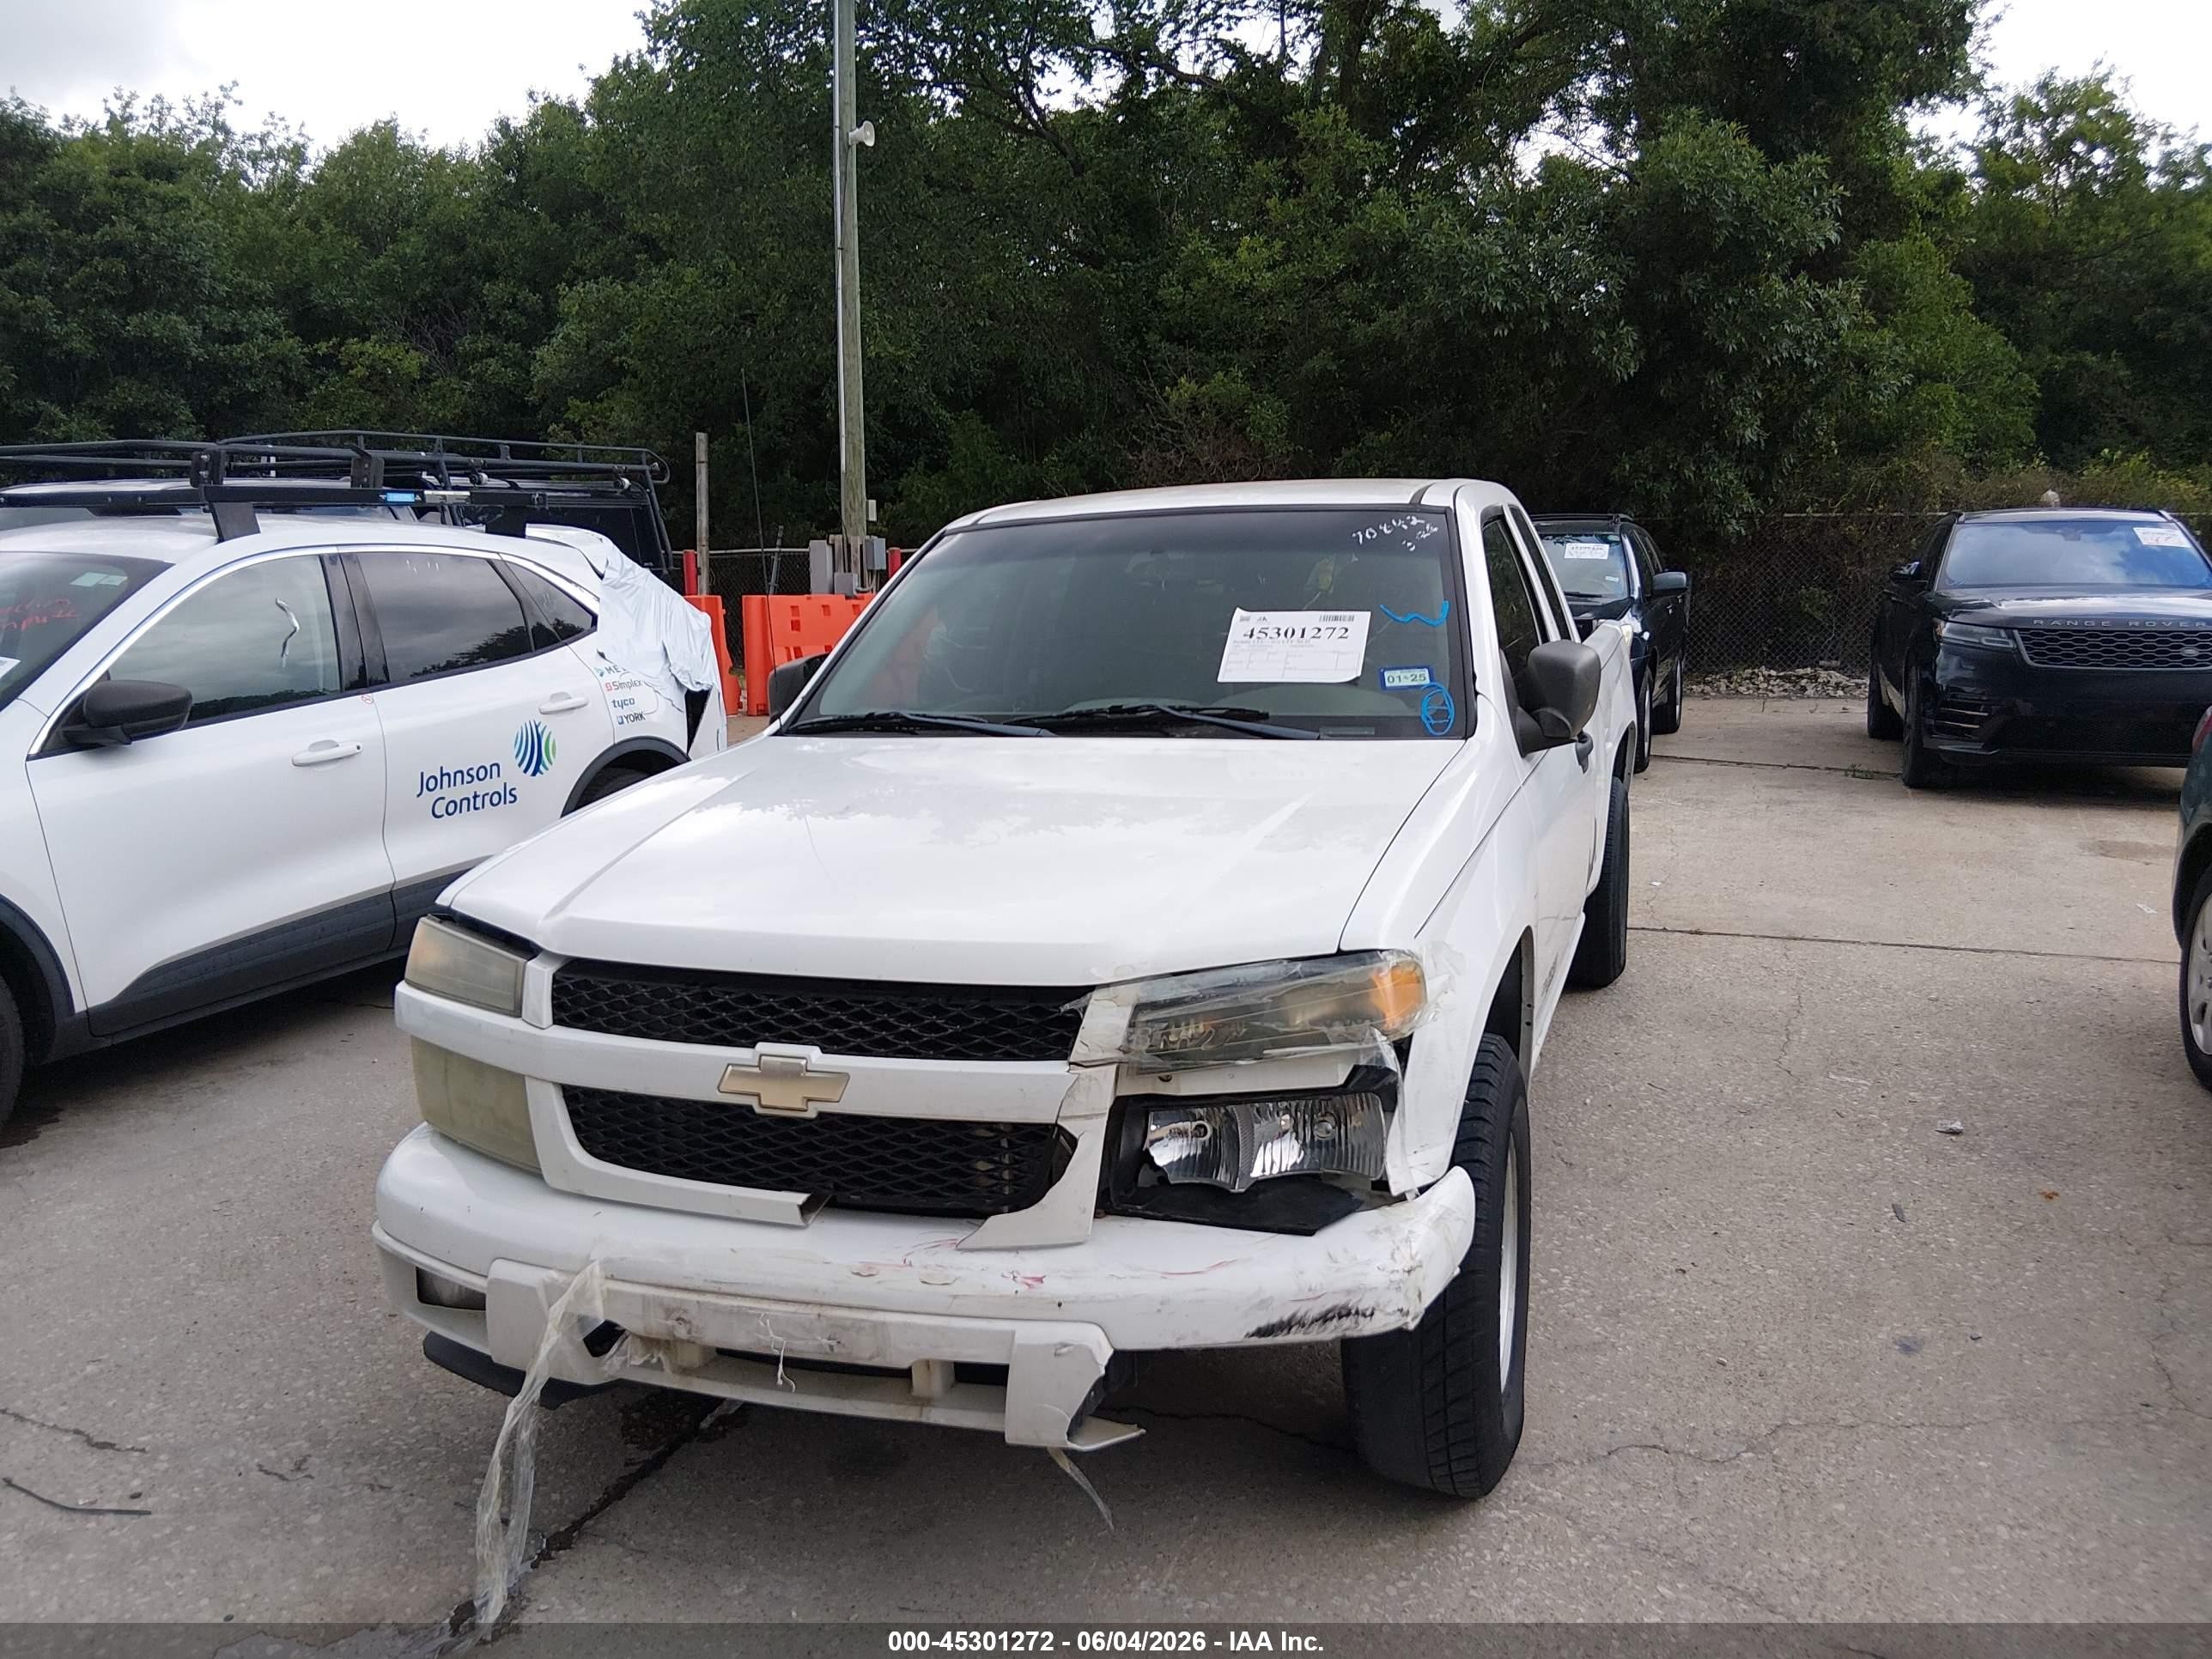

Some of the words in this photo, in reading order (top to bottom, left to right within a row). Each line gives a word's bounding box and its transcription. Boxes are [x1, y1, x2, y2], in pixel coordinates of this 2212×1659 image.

[2033, 619, 2111, 628] RANGE
[1243, 626, 1350, 640] 45301272
[612, 678, 642, 691] Simplex
[611, 697, 635, 710] tyco
[623, 711, 646, 723] YORK
[416, 762, 501, 799] Johnson
[431, 781, 518, 819] Controls
